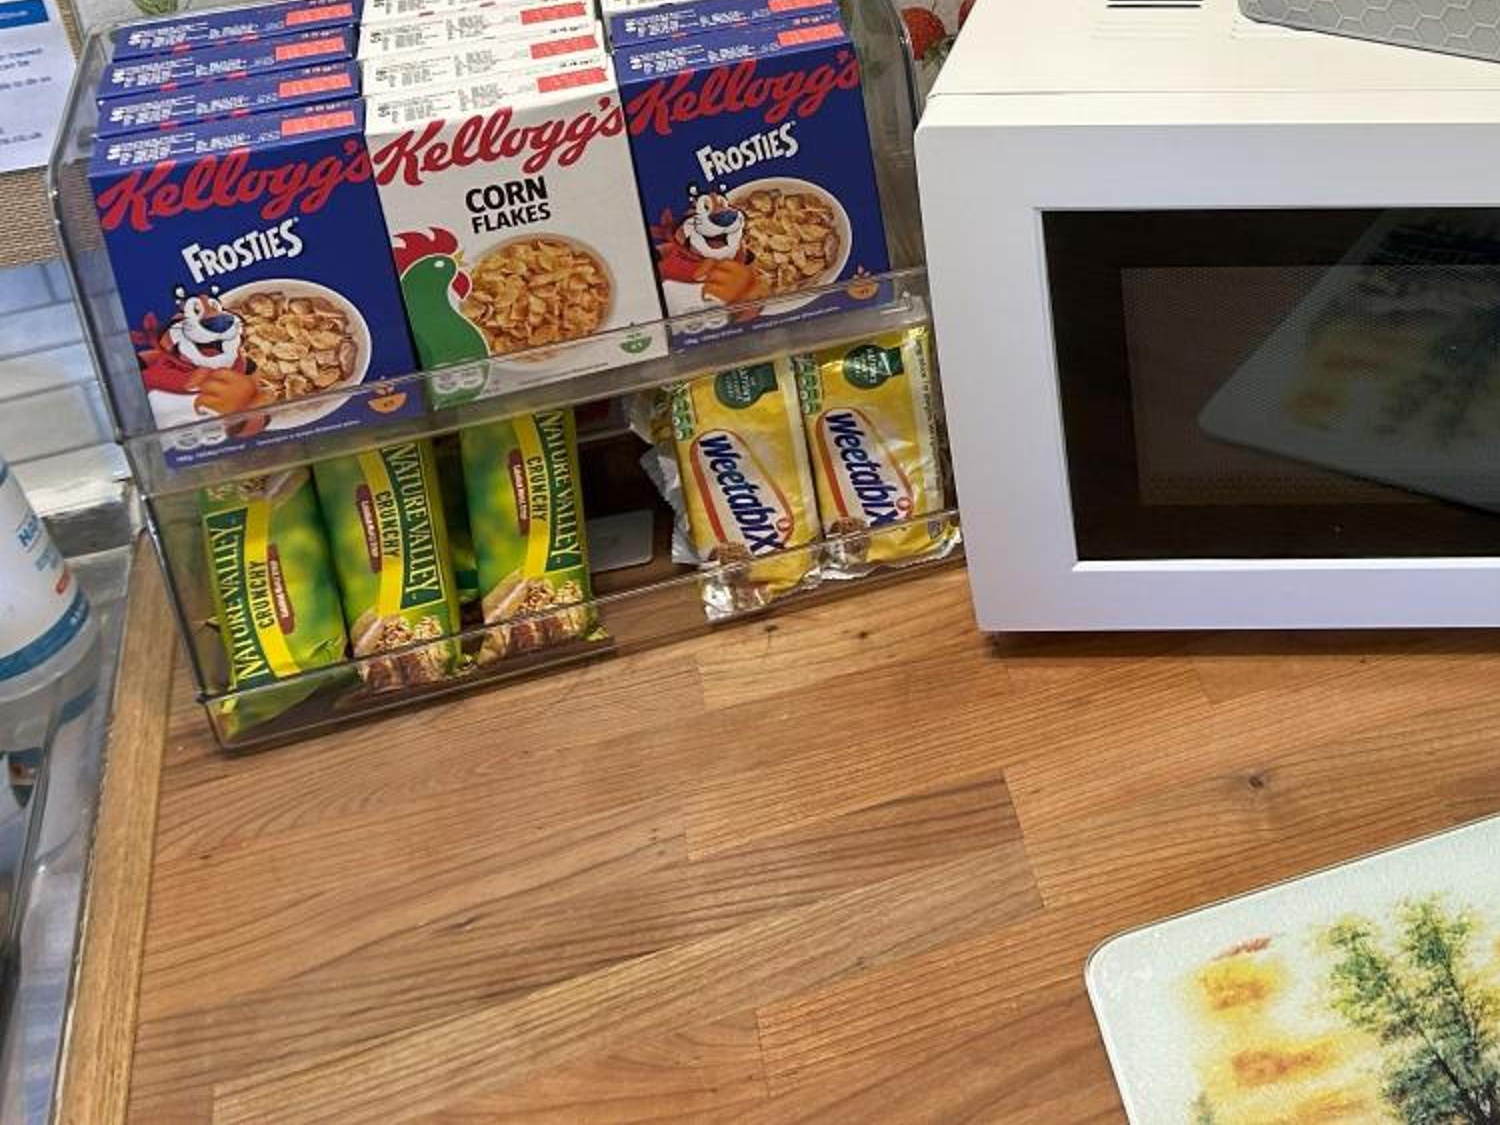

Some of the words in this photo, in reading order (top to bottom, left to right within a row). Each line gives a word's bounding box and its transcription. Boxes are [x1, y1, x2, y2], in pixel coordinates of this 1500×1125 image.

[626, 50, 862, 136] Kellogg's
[373, 95, 623, 187] Kellogg's
[696, 125, 799, 182] FROSTIES
[98, 139, 373, 231] Kellogg's
[465, 175, 549, 214] CORN
[471, 202, 551, 234] FLAKES
[182, 219, 304, 284] FROSTIES
[381, 441, 429, 523] NATURE
[526, 455, 547, 522] CRUNCHY
[699, 434, 785, 556] Weetabix
[825, 411, 904, 527] Weetabix
[375, 490, 400, 558] CRUNCHY
[404, 520, 440, 594] VALLEY
[551, 487, 582, 557] VALLEY
[210, 523, 244, 599] VALLEY
[248, 560, 275, 630] CRUNCHY
[224, 599, 270, 681] NATURE
